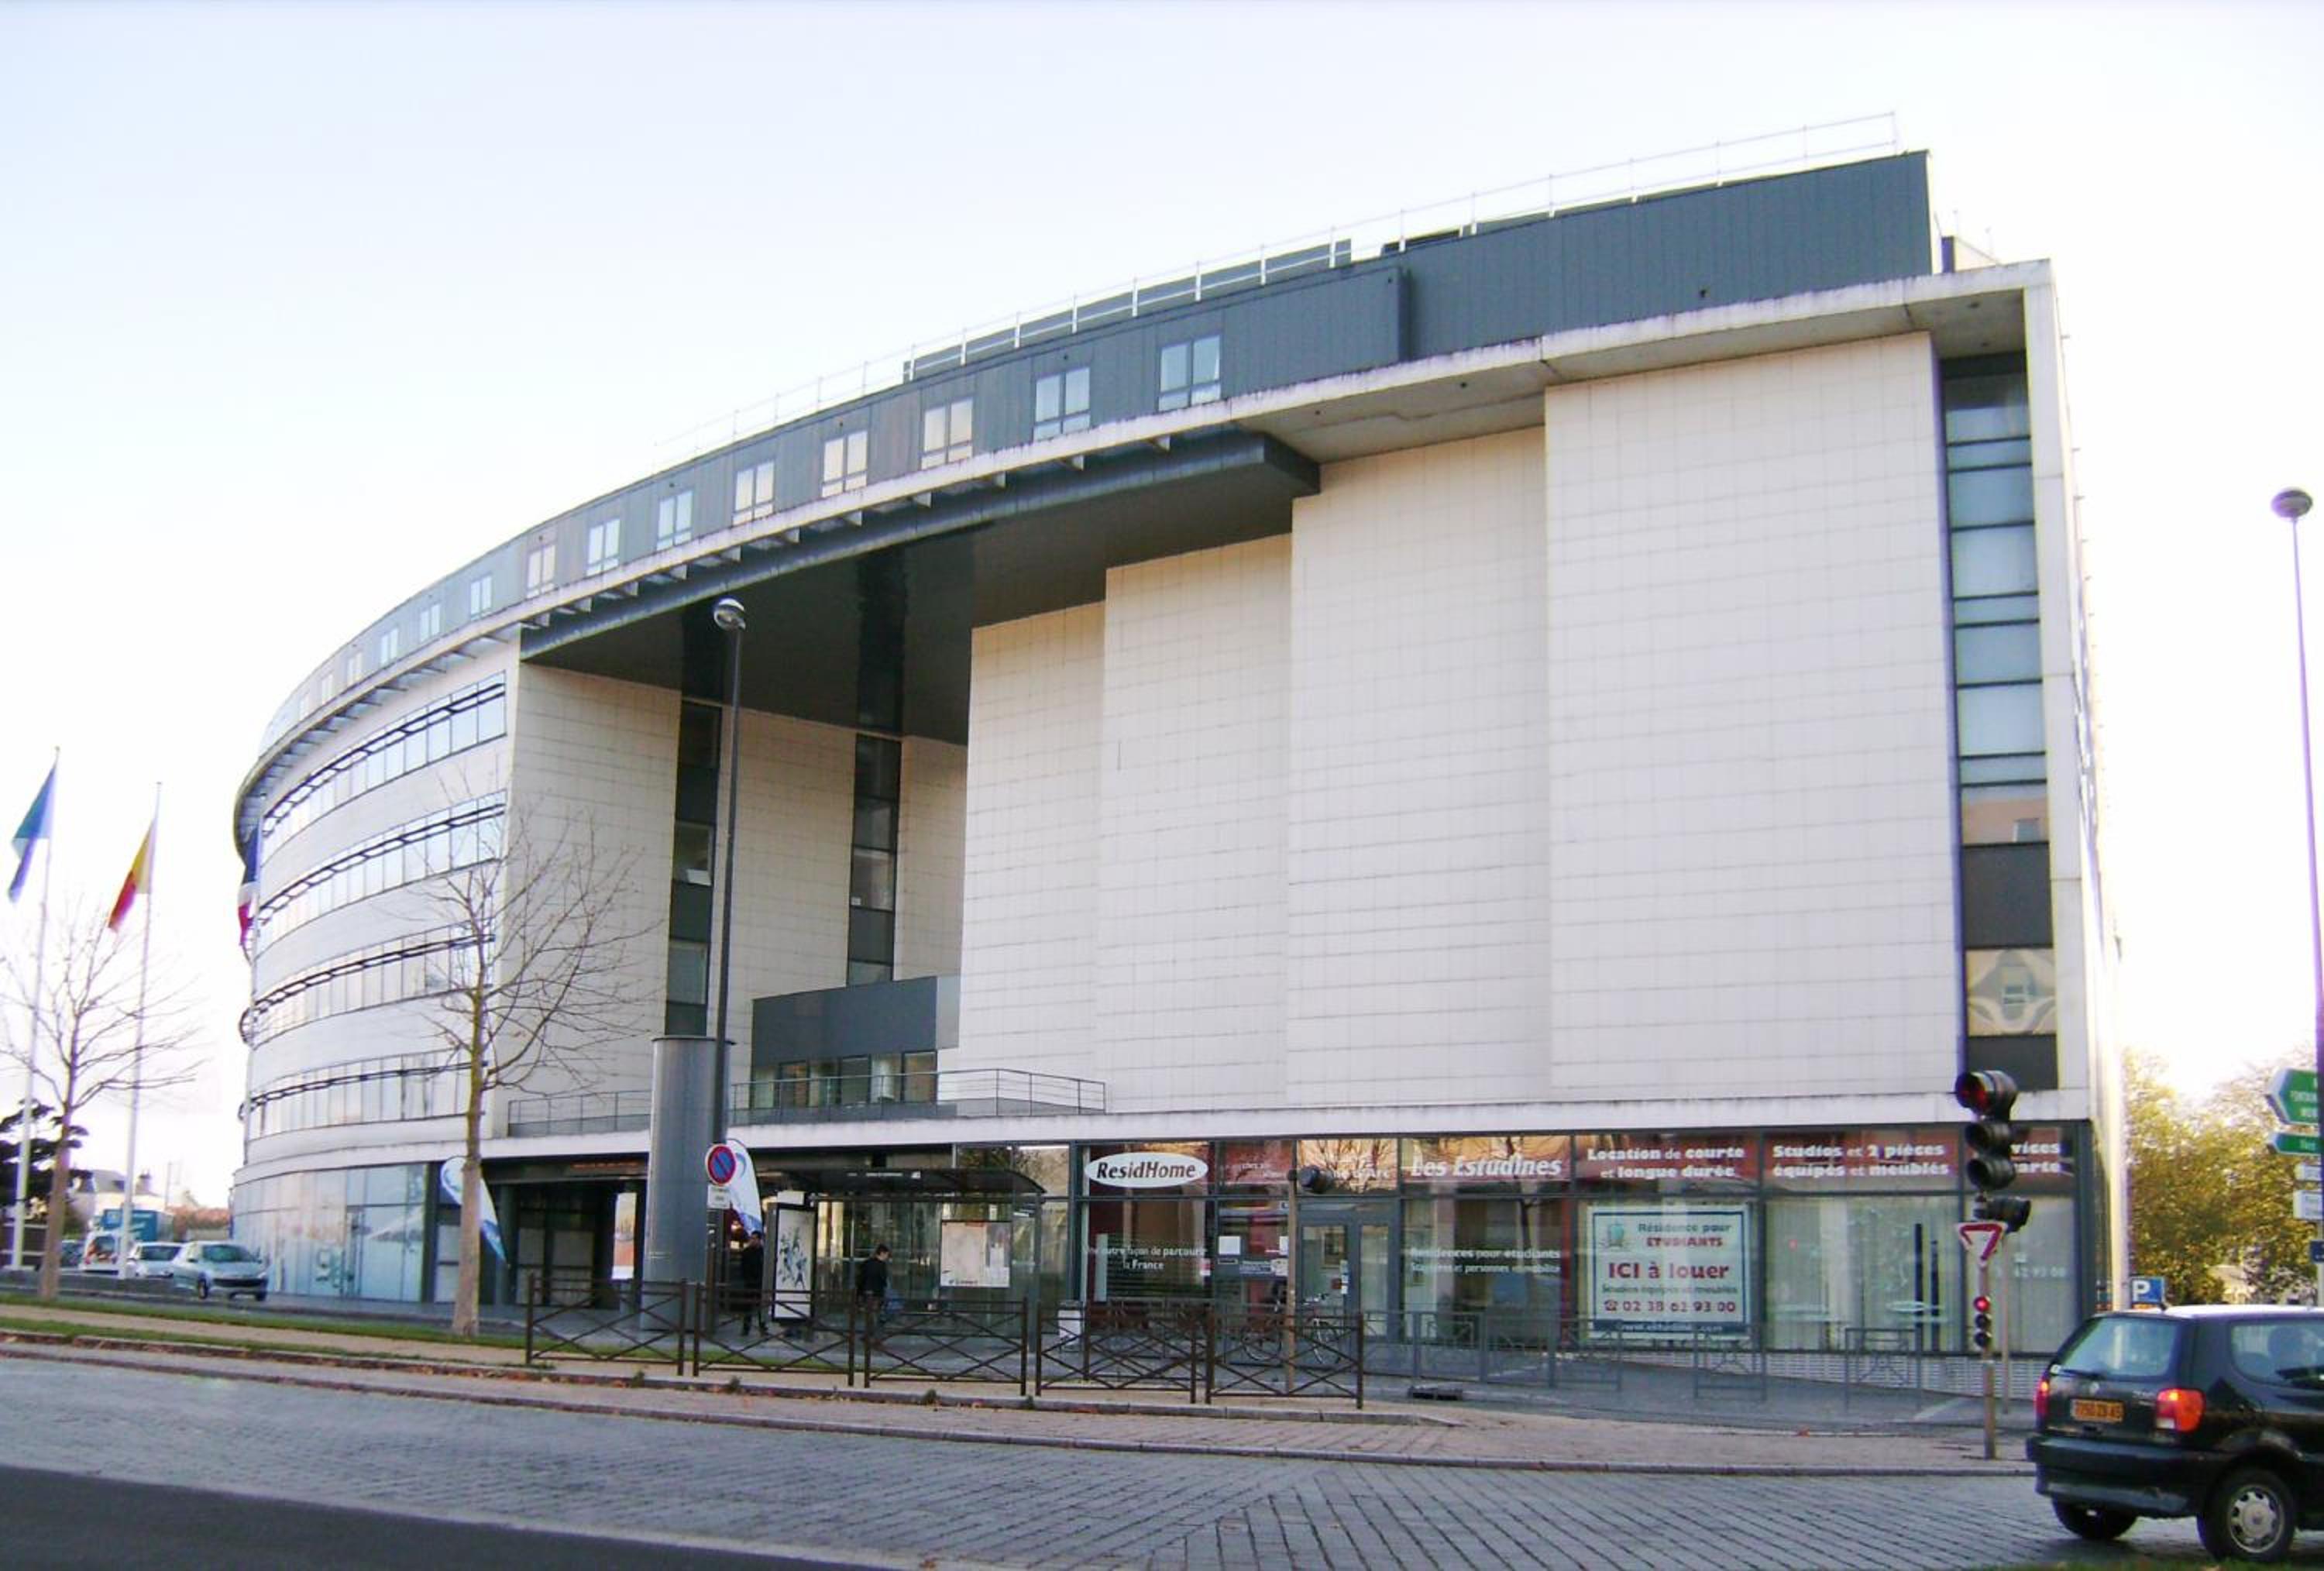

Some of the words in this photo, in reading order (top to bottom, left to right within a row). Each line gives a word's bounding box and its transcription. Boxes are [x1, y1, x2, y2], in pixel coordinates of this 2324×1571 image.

[1587, 1148, 1661, 1160] Location
[1665, 1148, 1680, 1160] de
[1685, 1146, 1745, 1159] courte
[1772, 1145, 1842, 1157] Studios
[1847, 1146, 1862, 1157] et
[1868, 1145, 1879, 1157] 2
[1885, 1144, 1945, 1159] pièces
[2010, 1141, 2059, 1153] vices
[1097, 1161, 1195, 1179] ResidHome
[1411, 1154, 1447, 1177] Les
[1600, 1169, 1614, 1178] et
[1618, 1167, 1677, 1179] longue
[1681, 1164, 1735, 1177] durée
[1772, 1163, 1845, 1177] équipés
[1849, 1166, 1865, 1176] et
[1869, 1163, 1949, 1176] meublés
[2014, 1163, 2060, 1173] arte
[1638, 1221, 1697, 1232] Résidence
[1703, 1224, 1731, 1235] pour
[1150, 1246, 1161, 1256] de
[1476, 1249, 1500, 1260] pour
[1132, 1259, 1164, 1270] France
[1609, 1263, 1640, 1279] ICI
[1648, 1260, 1661, 1279] à
[1669, 1263, 1729, 1279] louer
[2133, 1281, 2150, 1302] P
[1623, 1301, 1641, 1311] 02
[1693, 1301, 1711, 1311] 93
[1717, 1301, 1736, 1311] 00
